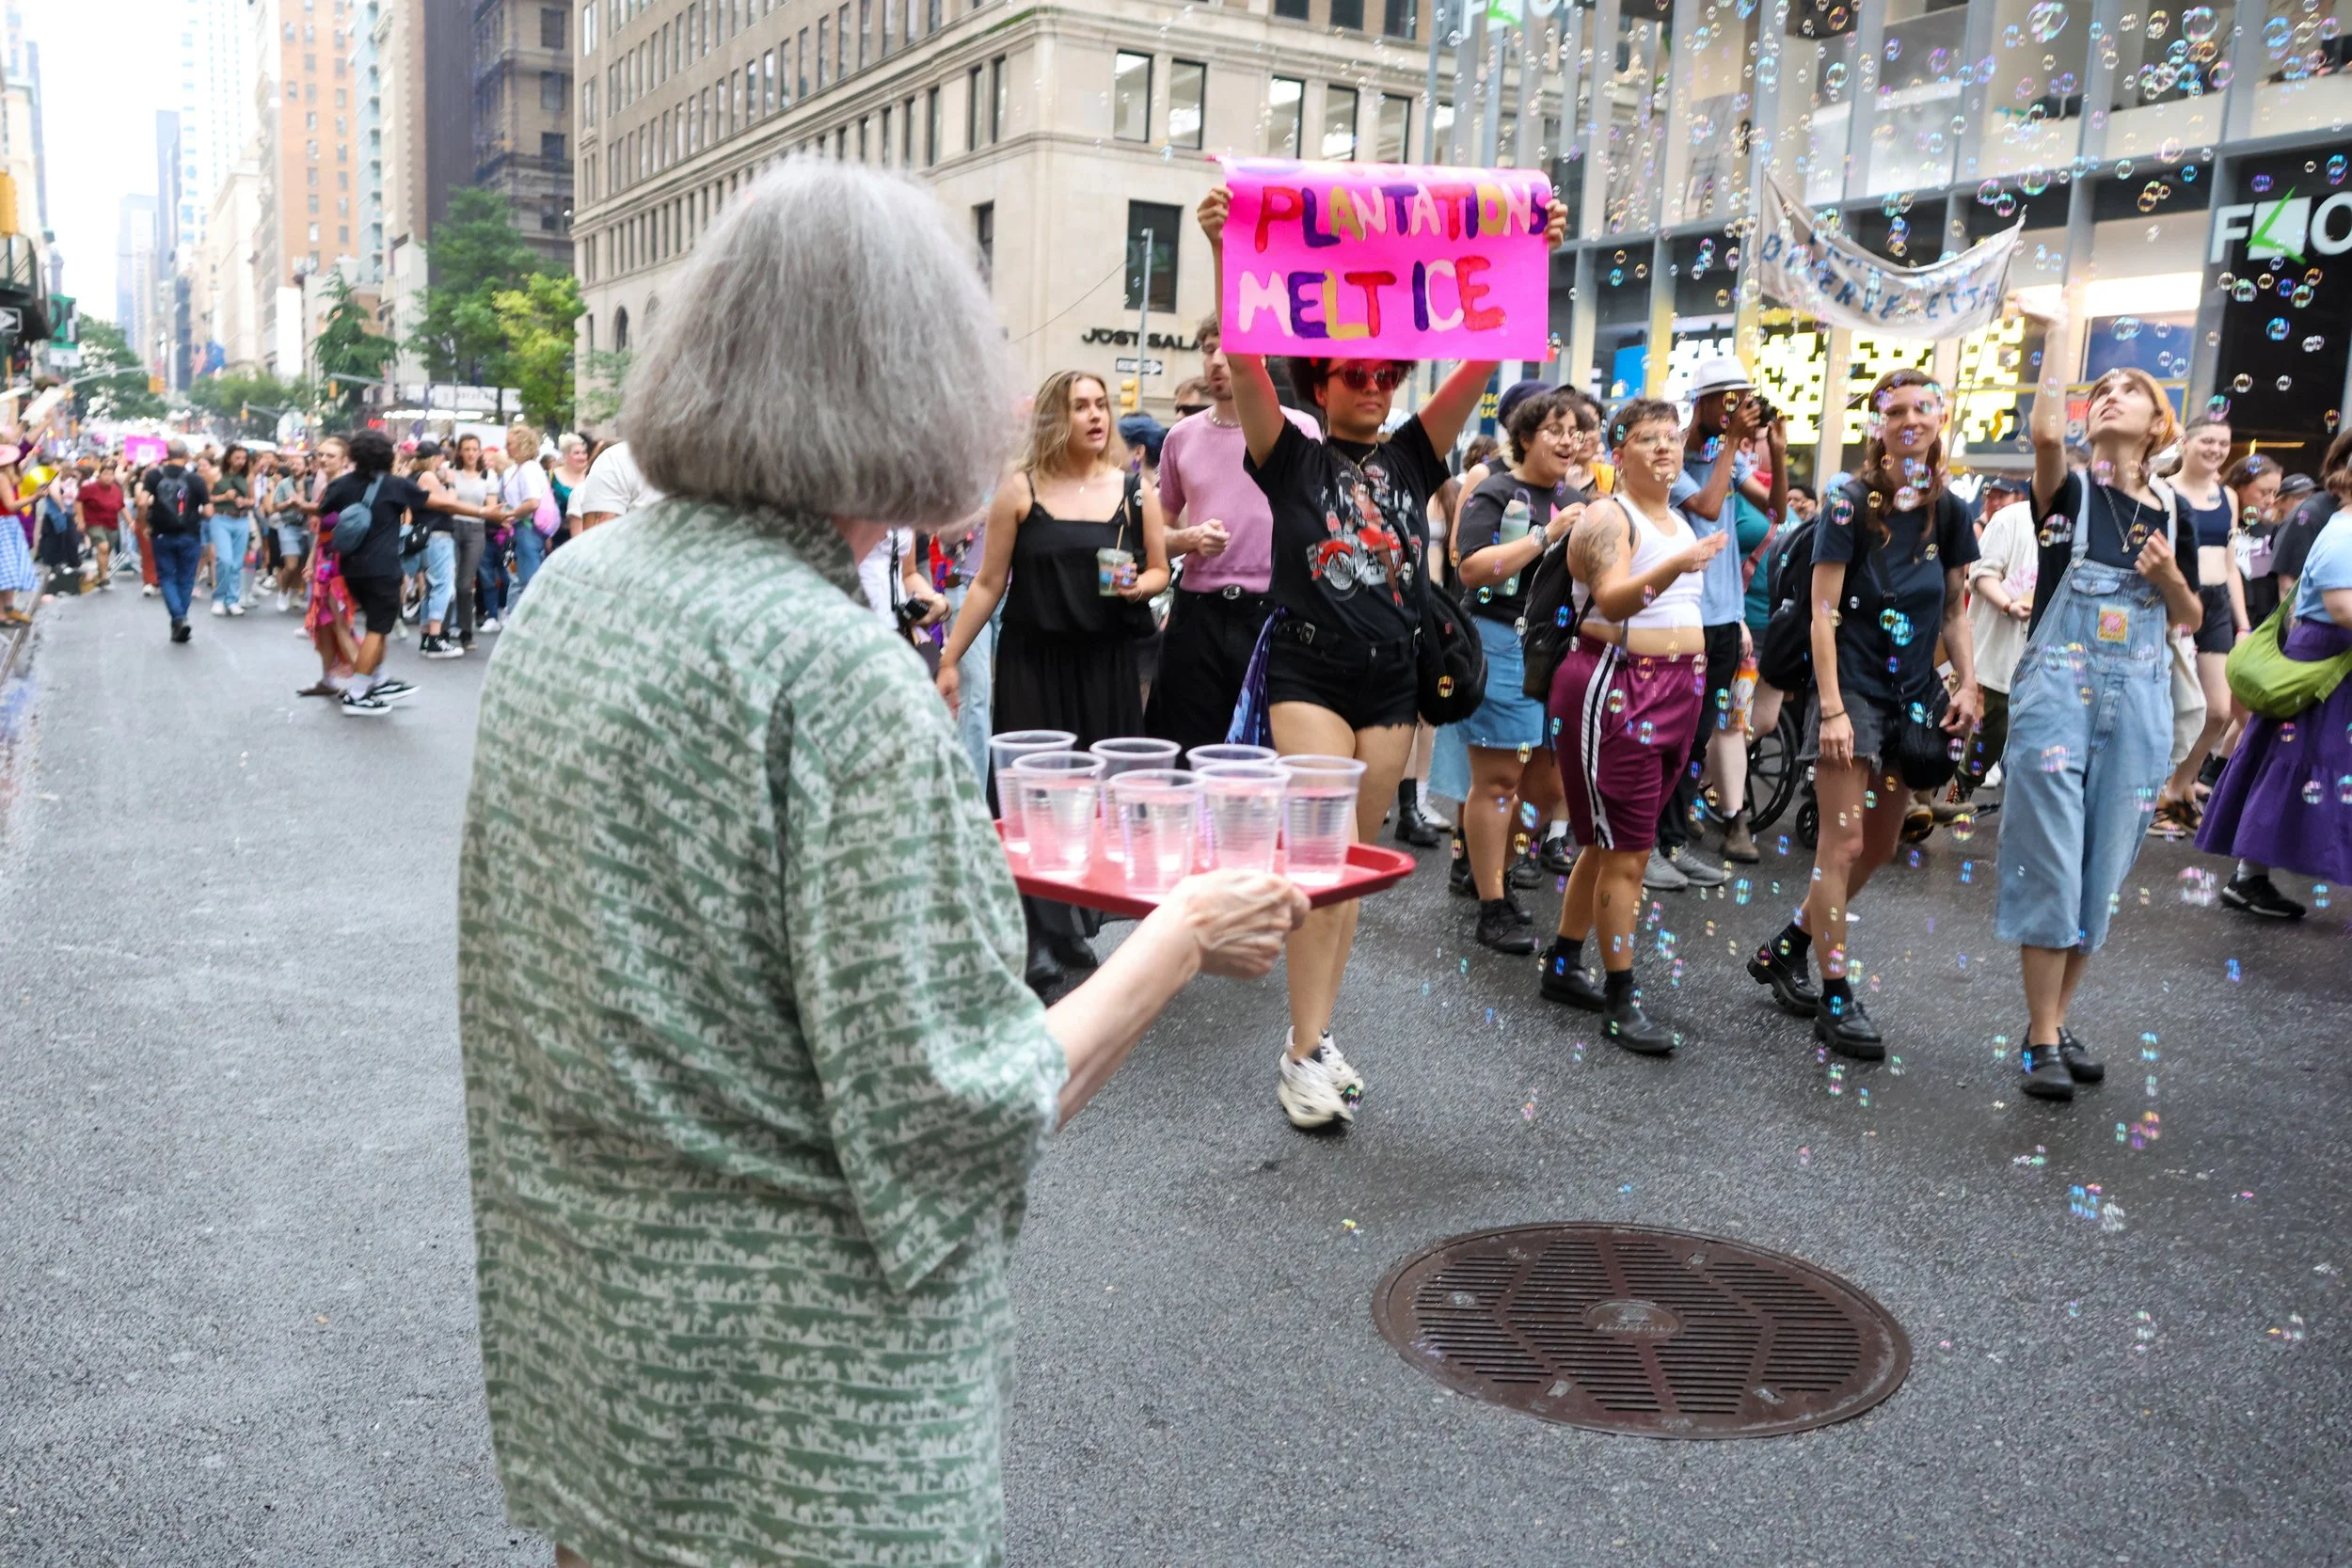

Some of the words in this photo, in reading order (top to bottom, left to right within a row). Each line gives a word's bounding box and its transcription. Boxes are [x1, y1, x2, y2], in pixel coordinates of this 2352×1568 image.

[1254, 182, 1549, 253] PLANTATIONS
[1238, 269, 1397, 341] MELT
[1412, 256, 1506, 332] ICE
